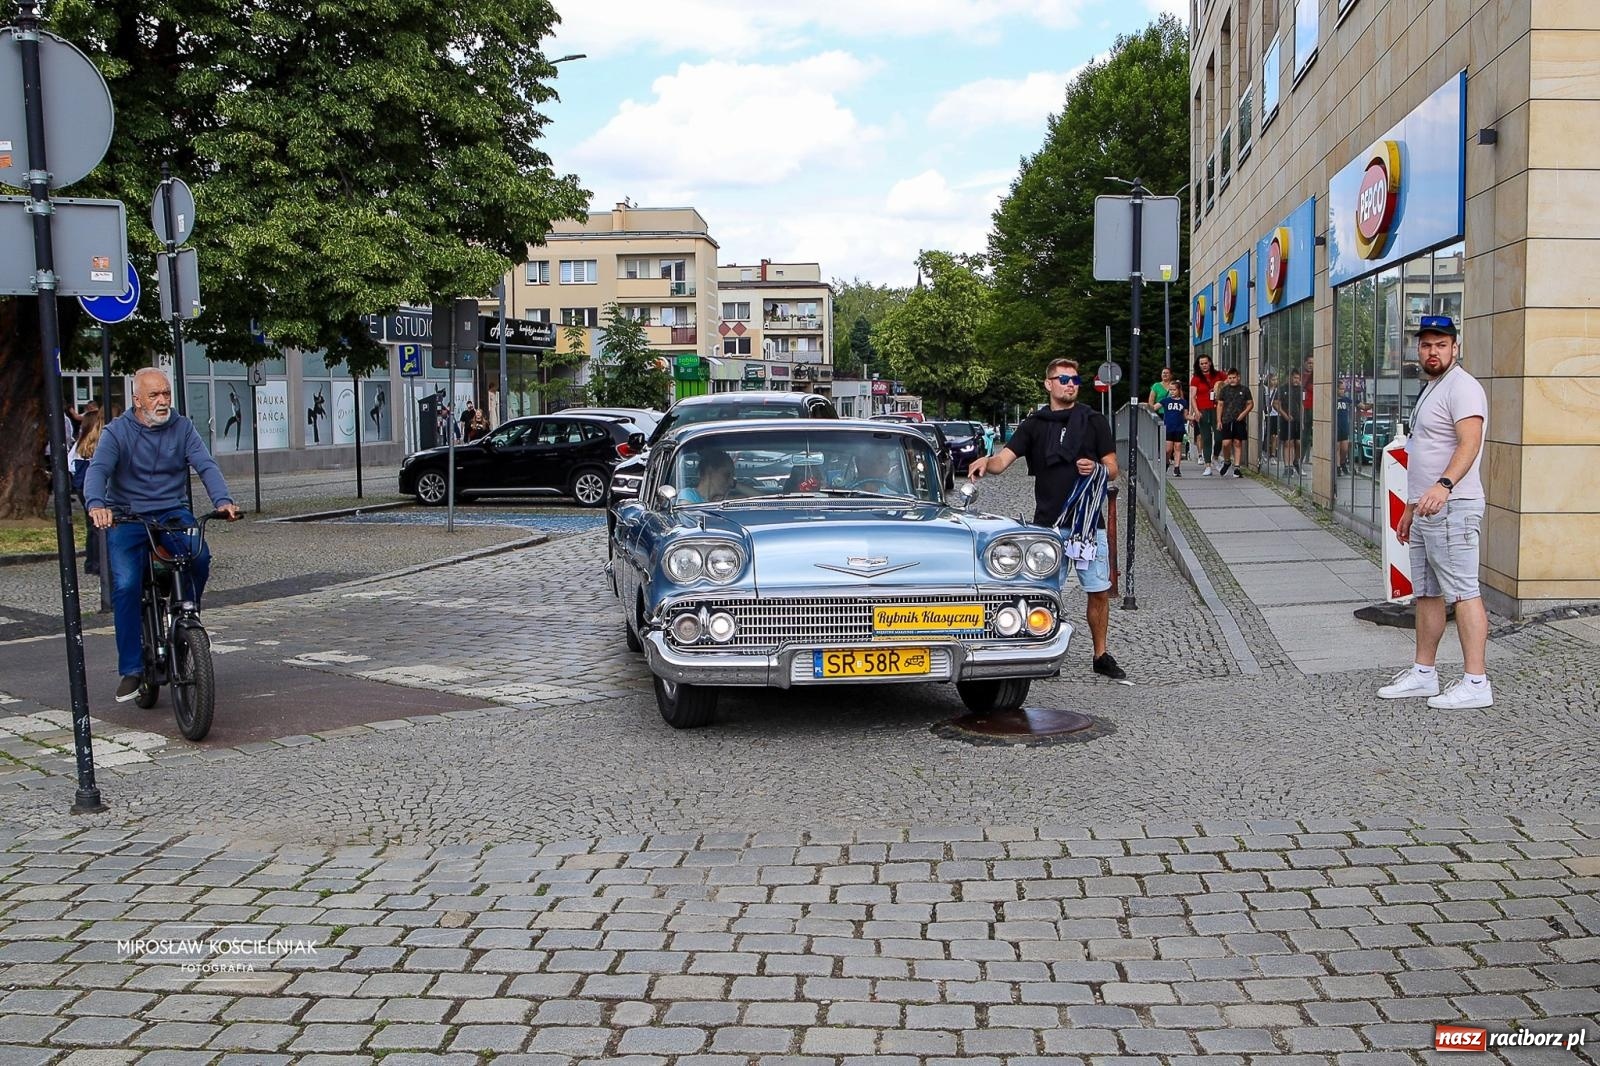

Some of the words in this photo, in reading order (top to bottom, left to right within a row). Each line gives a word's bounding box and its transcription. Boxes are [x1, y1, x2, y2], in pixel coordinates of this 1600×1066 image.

[1360, 179, 1384, 225] PEPCO
[404, 346, 414, 360] P
[257, 396, 285, 405] NAUKA
[877, 611, 918, 627] Rybnik
[922, 610, 979, 627] Klasyczny
[828, 654, 856, 674] SR
[864, 652, 900, 673] 58R
